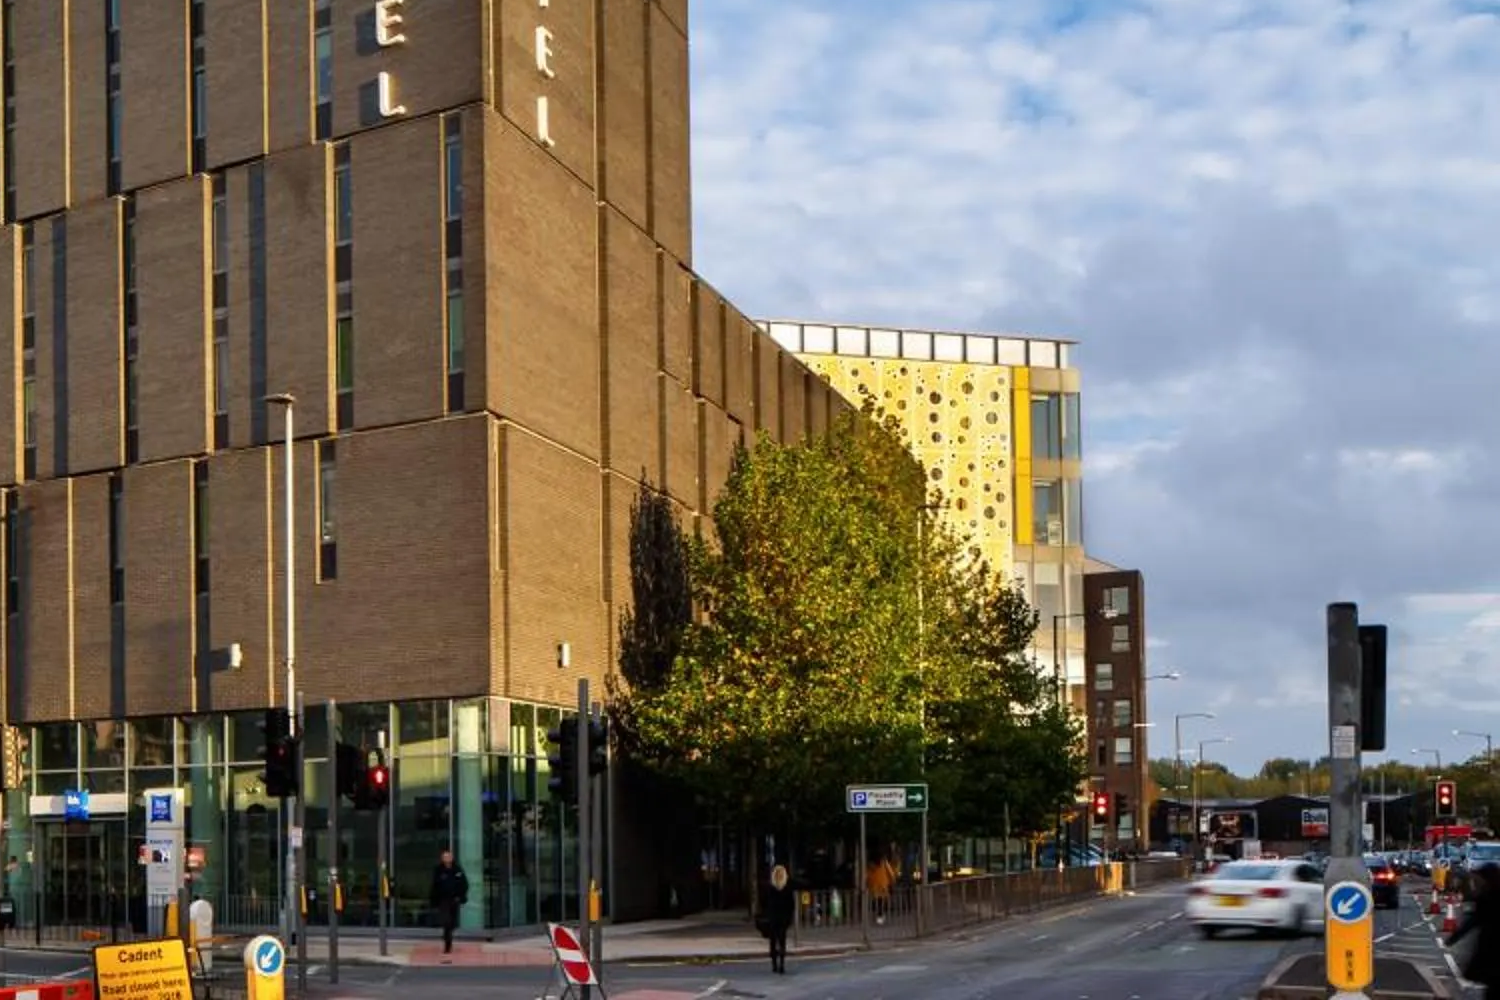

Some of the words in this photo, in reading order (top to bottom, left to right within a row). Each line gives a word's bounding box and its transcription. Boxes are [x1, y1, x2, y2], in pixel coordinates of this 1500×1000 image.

[118, 948, 164, 963] Cadent
[102, 984, 127, 995] Road
[130, 980, 160, 993] closed
